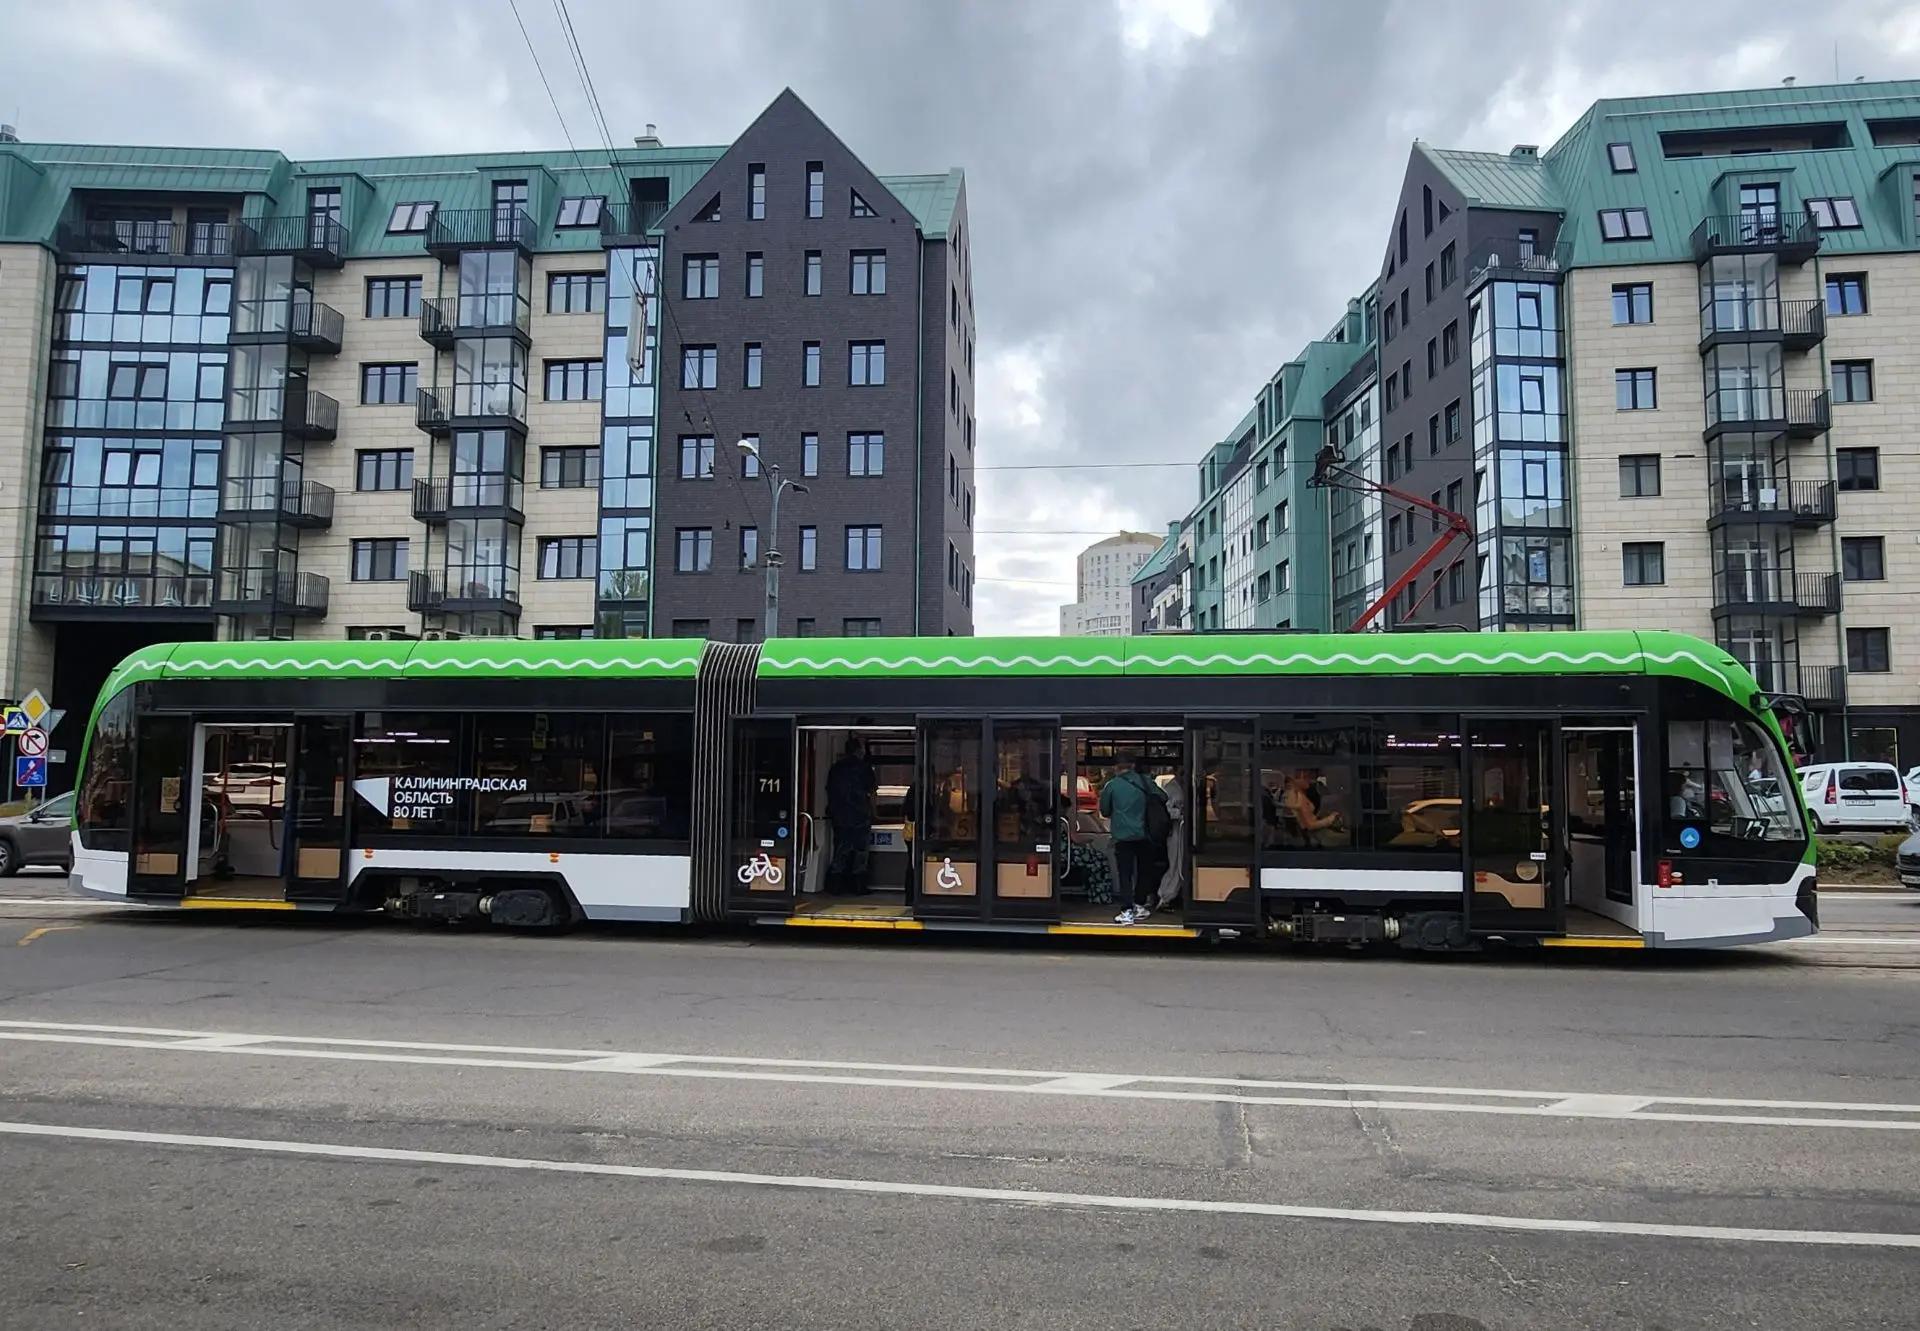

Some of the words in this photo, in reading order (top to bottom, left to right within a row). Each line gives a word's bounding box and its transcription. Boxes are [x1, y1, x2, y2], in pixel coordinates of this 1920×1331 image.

[394, 776, 528, 792] КАЛИНИНГРАДСКАЯ
[759, 778, 780, 793] 711
[394, 791, 454, 805] ОБЛАСТЬ
[393, 806, 410, 819] 80
[411, 806, 436, 819] ЛЕТ
